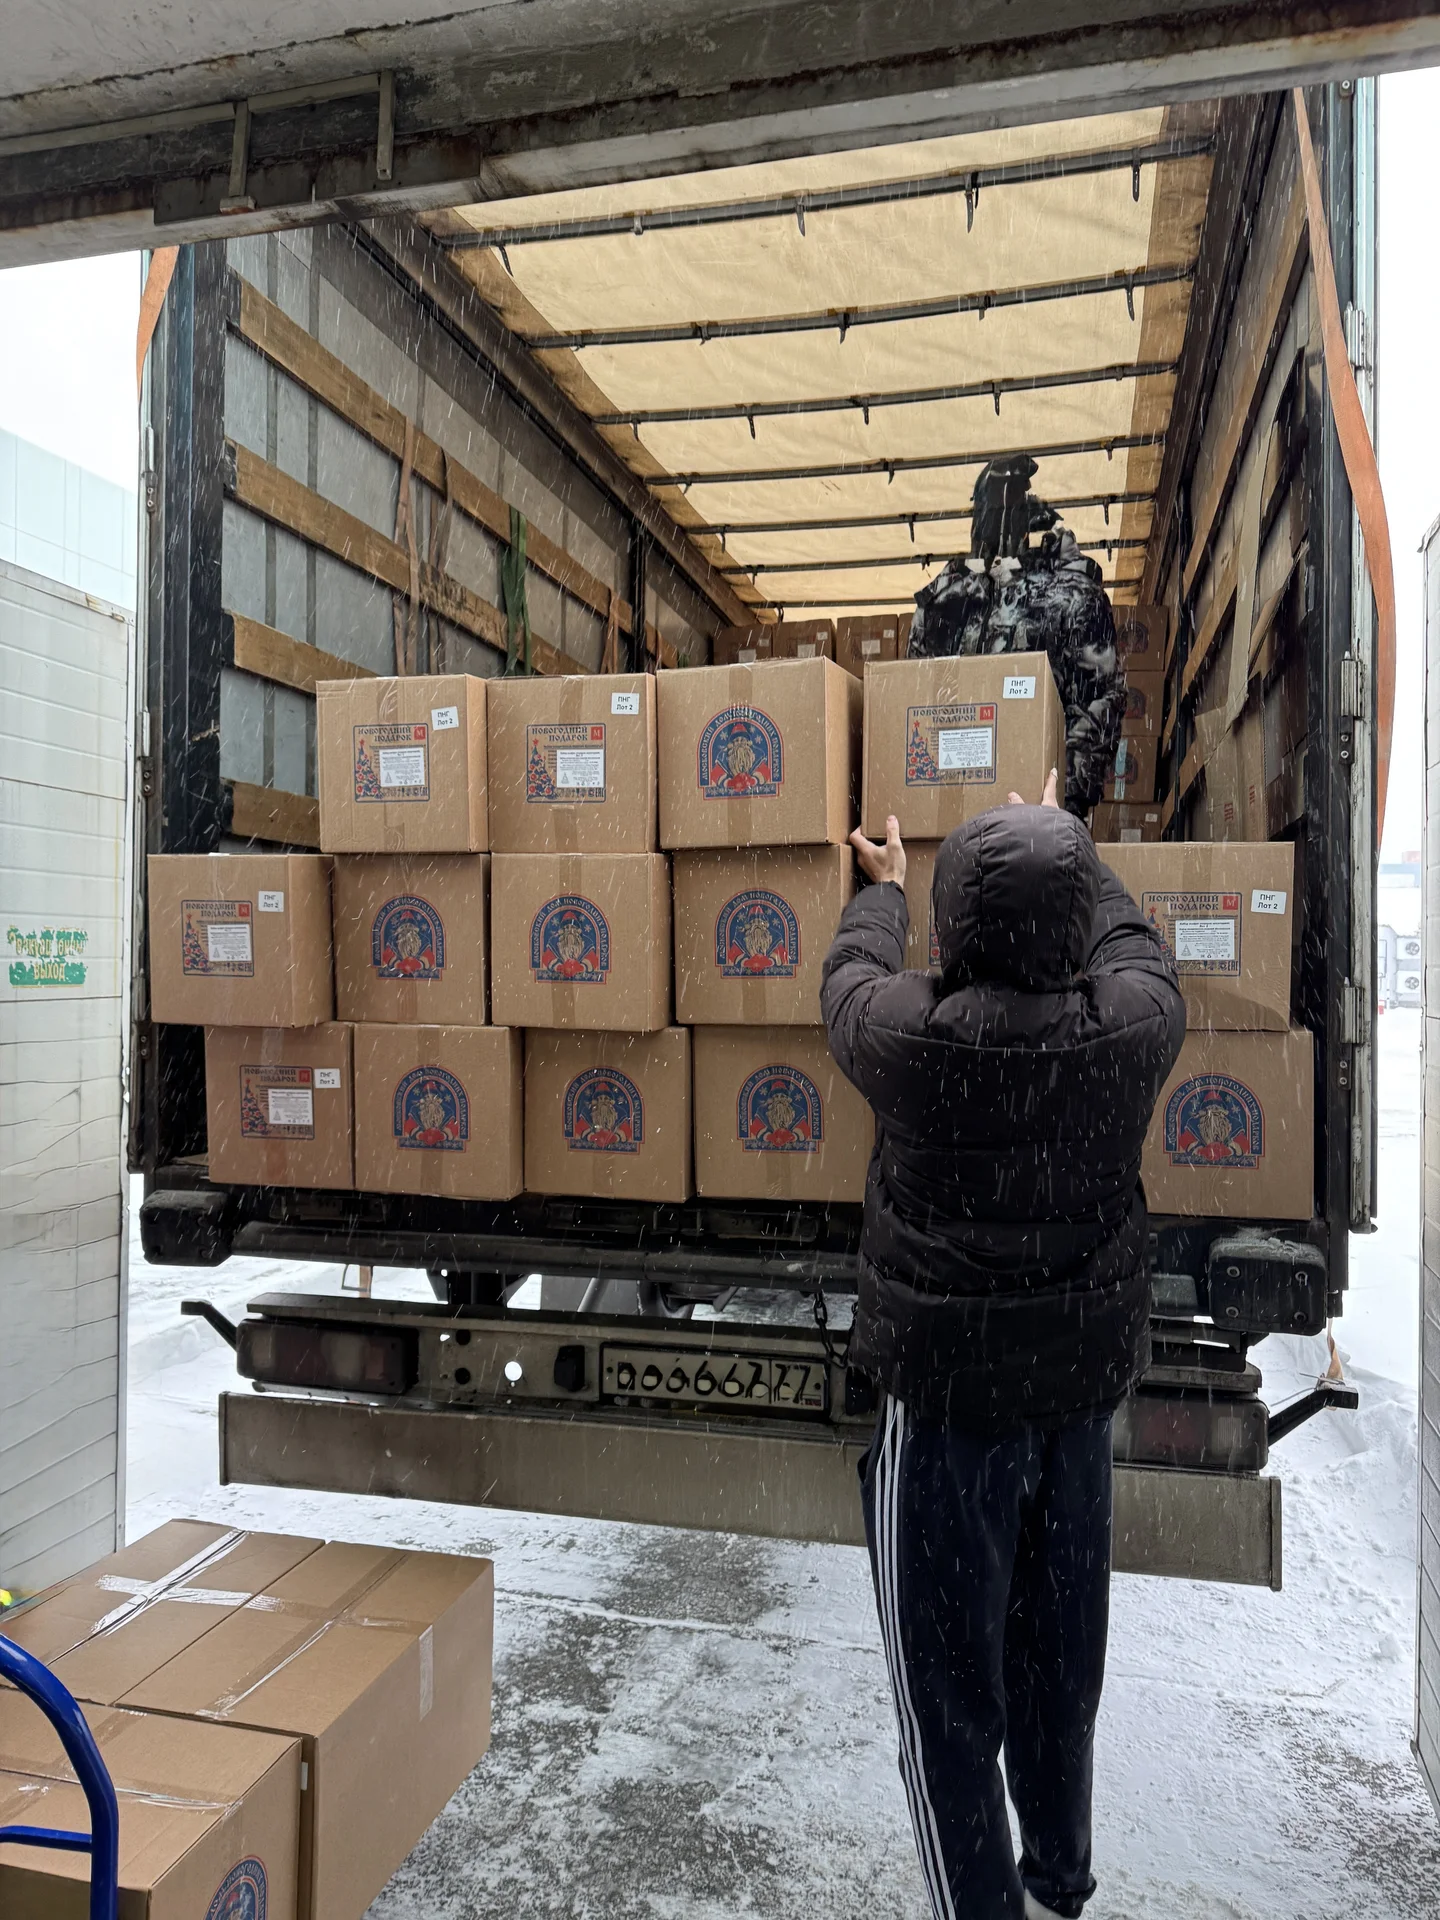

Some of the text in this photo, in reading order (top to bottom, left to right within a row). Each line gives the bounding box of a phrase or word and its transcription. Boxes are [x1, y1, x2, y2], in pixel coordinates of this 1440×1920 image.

[913, 705, 976, 717] НОВОГОДНИЙ
[932, 714, 976, 723] ПОДАРОК
[358, 726, 412, 735] НОВОГОДНИЙ
[531, 726, 588, 735] НОВОГОДНИЙ
[374, 734, 412, 743] ПОДАРОК
[548, 734, 588, 742] ПОДАРОК
[1148, 895, 1219, 903] НОВОГОДНИЙ
[1259, 893, 1276, 901] ПНГ
[1169, 903, 1219, 911] ПОДАРОК
[1257, 901, 1272, 909] Лот
